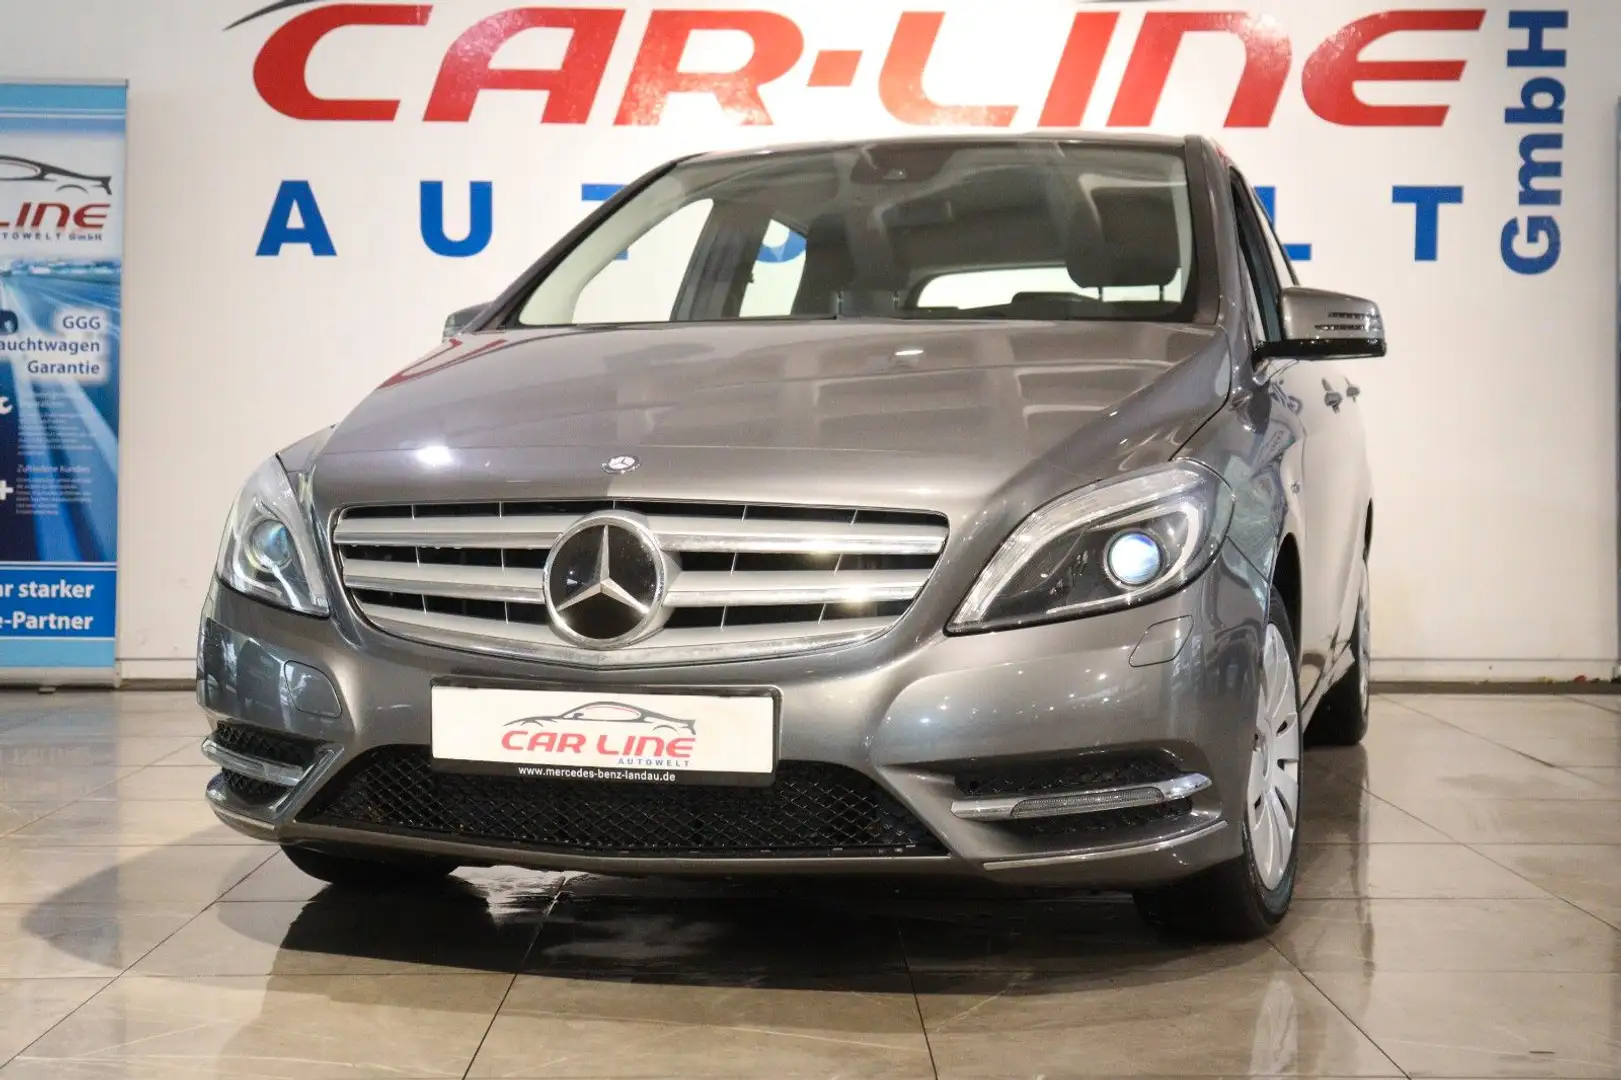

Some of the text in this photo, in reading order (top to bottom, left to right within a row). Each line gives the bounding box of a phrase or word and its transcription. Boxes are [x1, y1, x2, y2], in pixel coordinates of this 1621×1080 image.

[1500, 10, 1569, 276] GmbH
[69, 233, 102, 241] GmbH
[62, 315, 101, 330] GGG
[27, 359, 100, 375] Garantie
[18, 579, 95, 598] starker
[501, 730, 696, 758] CAR LINE
[618, 757, 690, 767] AUTOWELT
[518, 766, 676, 782] www.mercedes-benz-landau.de
